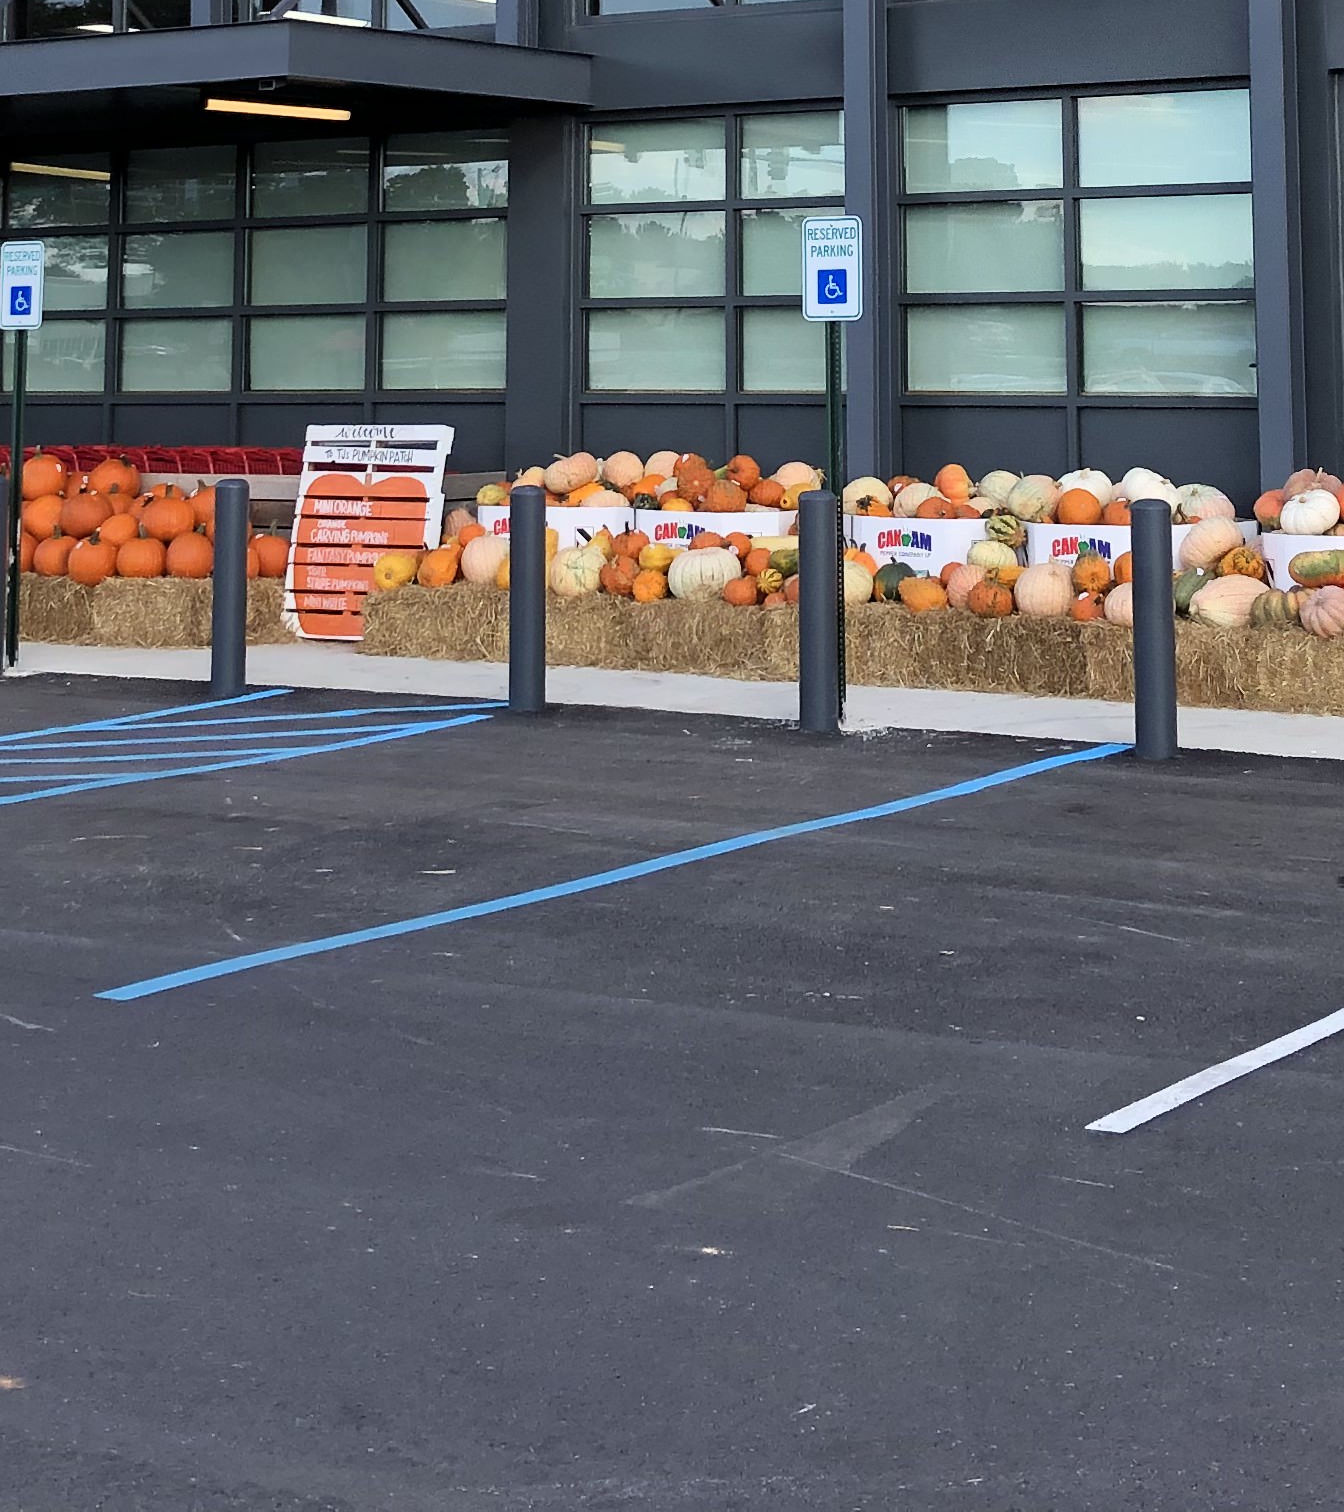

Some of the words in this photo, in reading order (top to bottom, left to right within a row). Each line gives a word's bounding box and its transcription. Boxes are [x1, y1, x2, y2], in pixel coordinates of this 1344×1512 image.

[807, 226, 857, 241] RESERVED
[4, 250, 41, 262] RESERVED
[810, 244, 854, 257] PARKING
[7, 265, 38, 276] PARKING
[352, 449, 388, 464] PUMPKIN
[389, 450, 414, 465] PATCH
[334, 500, 373, 517] ORANGE
[494, 518, 511, 536] CA
[654, 522, 678, 541] CAN
[311, 529, 350, 543] CARVING
[877, 529, 901, 549] CAN
[910, 530, 932, 552] AM
[1052, 536, 1078, 558] CAN
